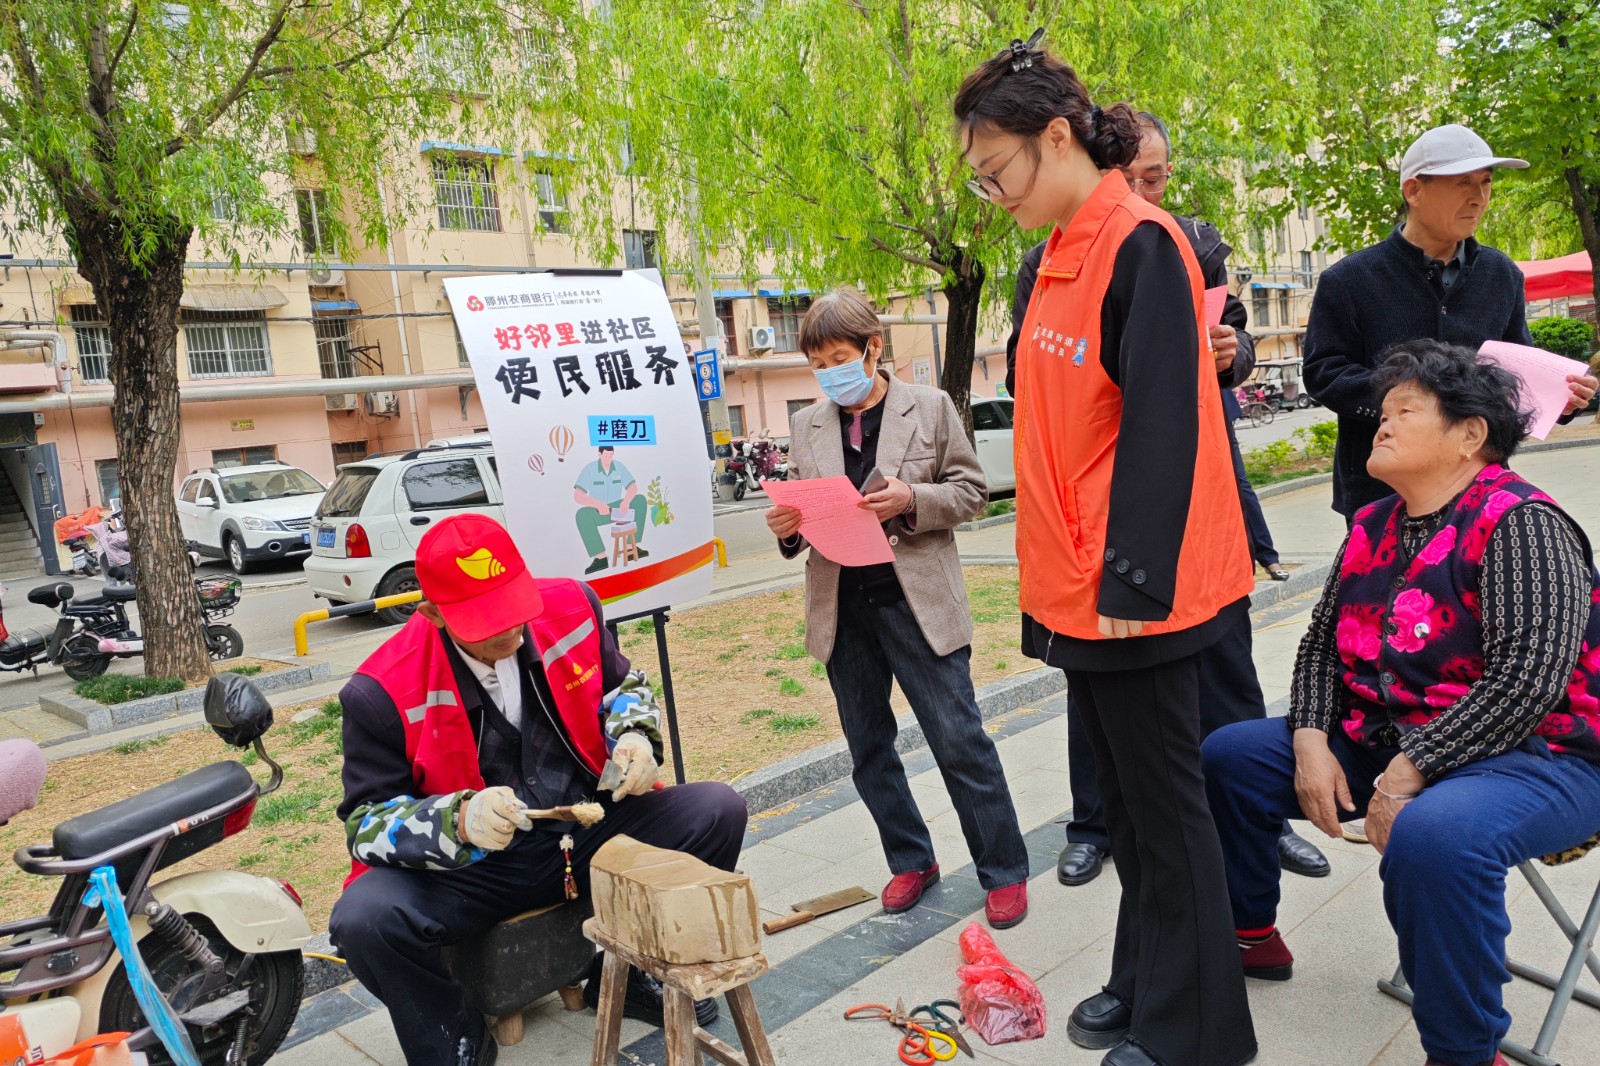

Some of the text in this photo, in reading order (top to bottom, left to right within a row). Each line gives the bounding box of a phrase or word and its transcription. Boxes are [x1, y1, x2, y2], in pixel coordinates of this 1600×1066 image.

[484, 292, 552, 306] 滕州农商银行
[494, 316, 656, 351] 好邻里进社区
[495, 345, 679, 404] 便民服务
[597, 418, 647, 440] #磨刀
